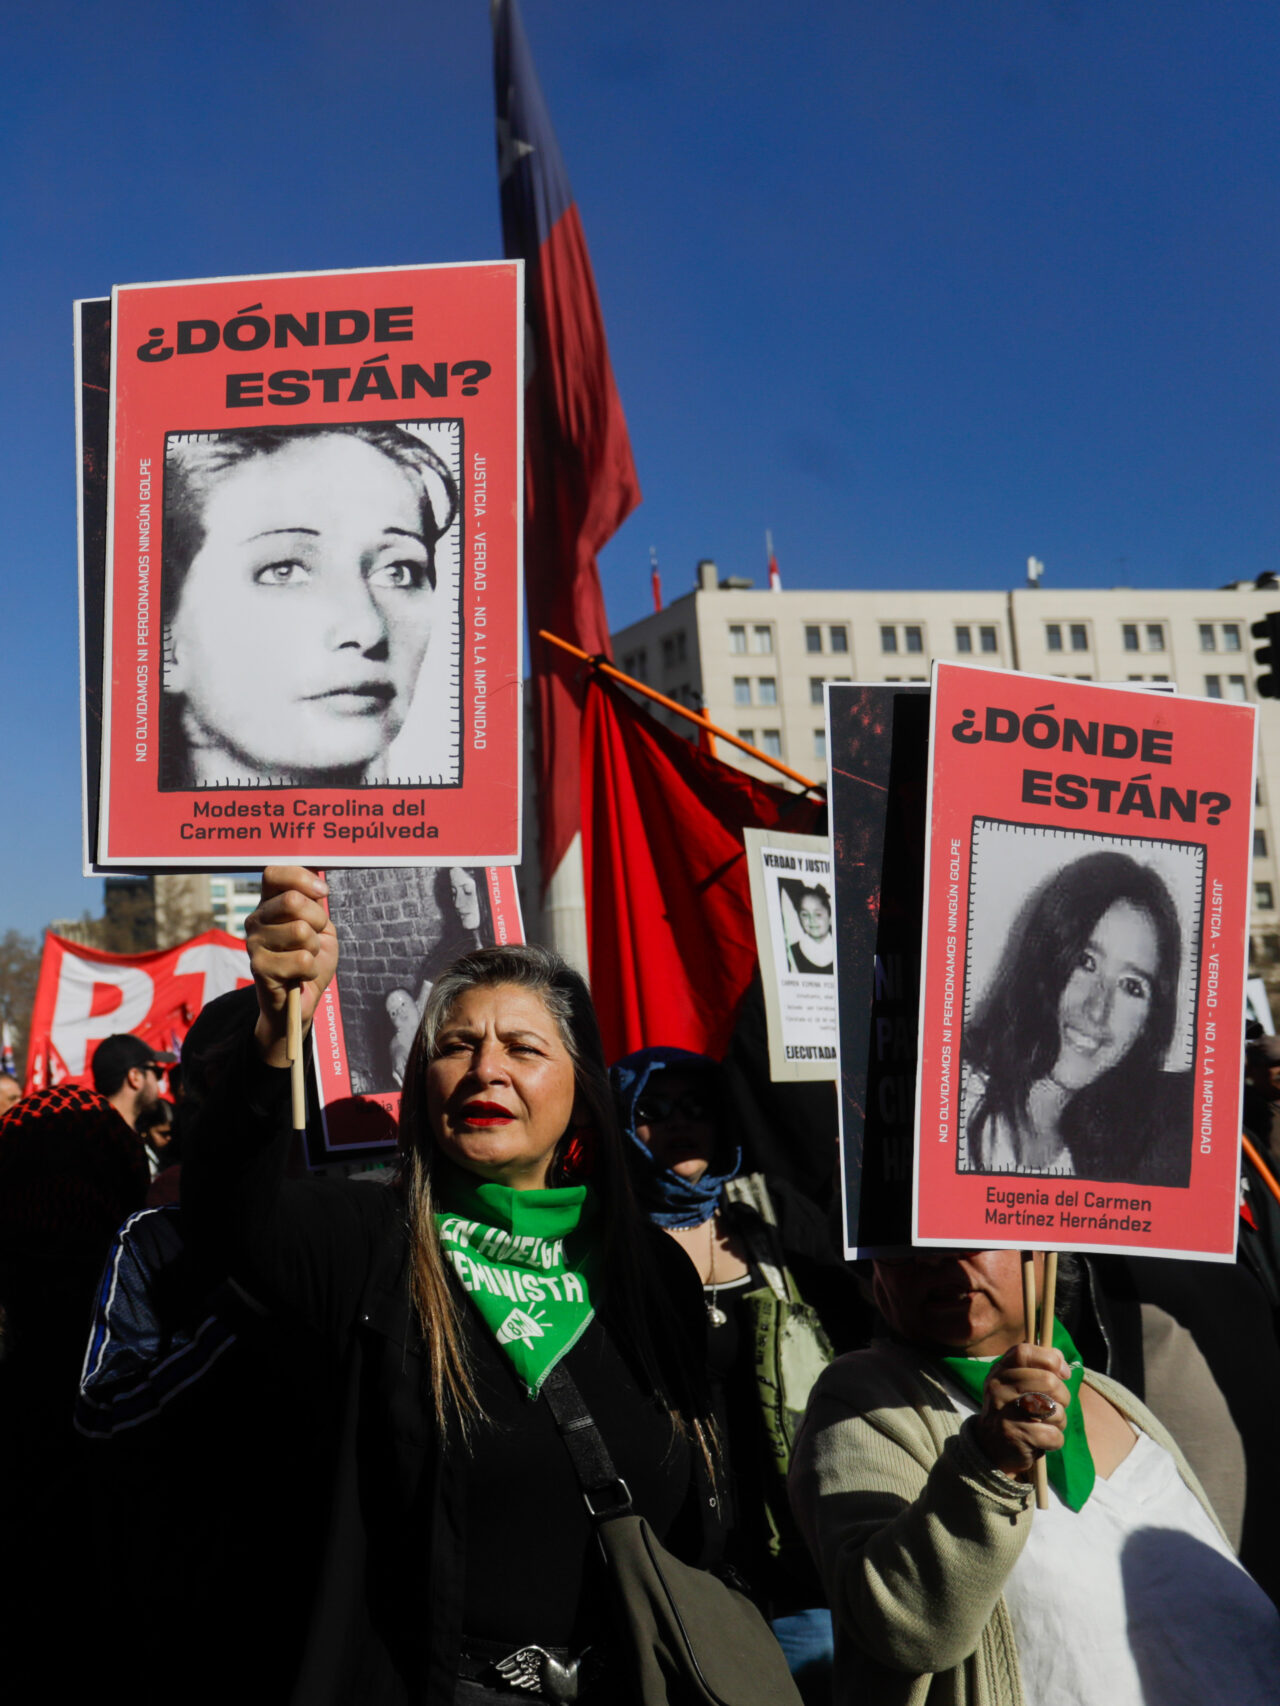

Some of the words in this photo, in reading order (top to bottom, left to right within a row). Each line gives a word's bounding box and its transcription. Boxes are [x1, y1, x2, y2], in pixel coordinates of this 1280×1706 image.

[136, 302, 414, 363] ¿DÓNDE
[225, 353, 492, 409] ESTÁN?
[140, 458, 151, 501] GOLPE
[474, 453, 486, 517] JUSTICIA
[137, 503, 150, 552] NINGÚN
[474, 532, 486, 590] VERDAD
[137, 554, 149, 646] PERDONAMOS
[474, 606, 486, 627] NO
[137, 648, 148, 662] NI
[474, 631, 486, 642] A
[474, 646, 486, 665] LA
[136, 664, 148, 740] OLVIDAMOS
[474, 669, 486, 750] IMPUNIDAD
[135, 743, 147, 762] NO
[951, 704, 1174, 766] ¿DÓNDE
[193, 799, 285, 818] Modesta
[292, 799, 384, 817] Carolina
[392, 799, 426, 817] del
[1021, 769, 1232, 826] ESTÁN?
[180, 822, 262, 840] Carmen
[269, 821, 316, 839] Wiff
[323, 821, 439, 844] Sepúlveda
[764, 853, 797, 870] VERDAD
[798, 858, 803, 872] Y
[950, 838, 960, 881] GOLPE
[947, 883, 958, 933] NINGÚN
[1211, 878, 1223, 939] JUSTICIA
[325, 993, 333, 1004] NI
[944, 935, 956, 1027] PERDONAMOS
[1207, 953, 1219, 1008] VERDAD
[326, 1005, 340, 1060] OLVIDAMOS
[786, 1045, 837, 1060] EJECUTADA
[942, 1029, 952, 1043] NI
[1205, 1021, 1217, 1041] NO
[1205, 1044, 1216, 1054] A
[334, 1062, 342, 1075] NO
[939, 1045, 951, 1121] OLVIDAMOS
[1203, 1058, 1215, 1076] LA
[938, 1123, 948, 1143] NO
[1200, 1079, 1213, 1155] IMPUNIDAD
[984, 1207, 1055, 1228] Martínez
[1059, 1211, 1153, 1233] Hernández
[985, 1187, 1049, 1208] Eugenia
[1054, 1191, 1079, 1208] del
[1083, 1192, 1153, 1213] Carmen
[440, 1218, 480, 1248] EN
[477, 1227, 568, 1270] HUELGA
